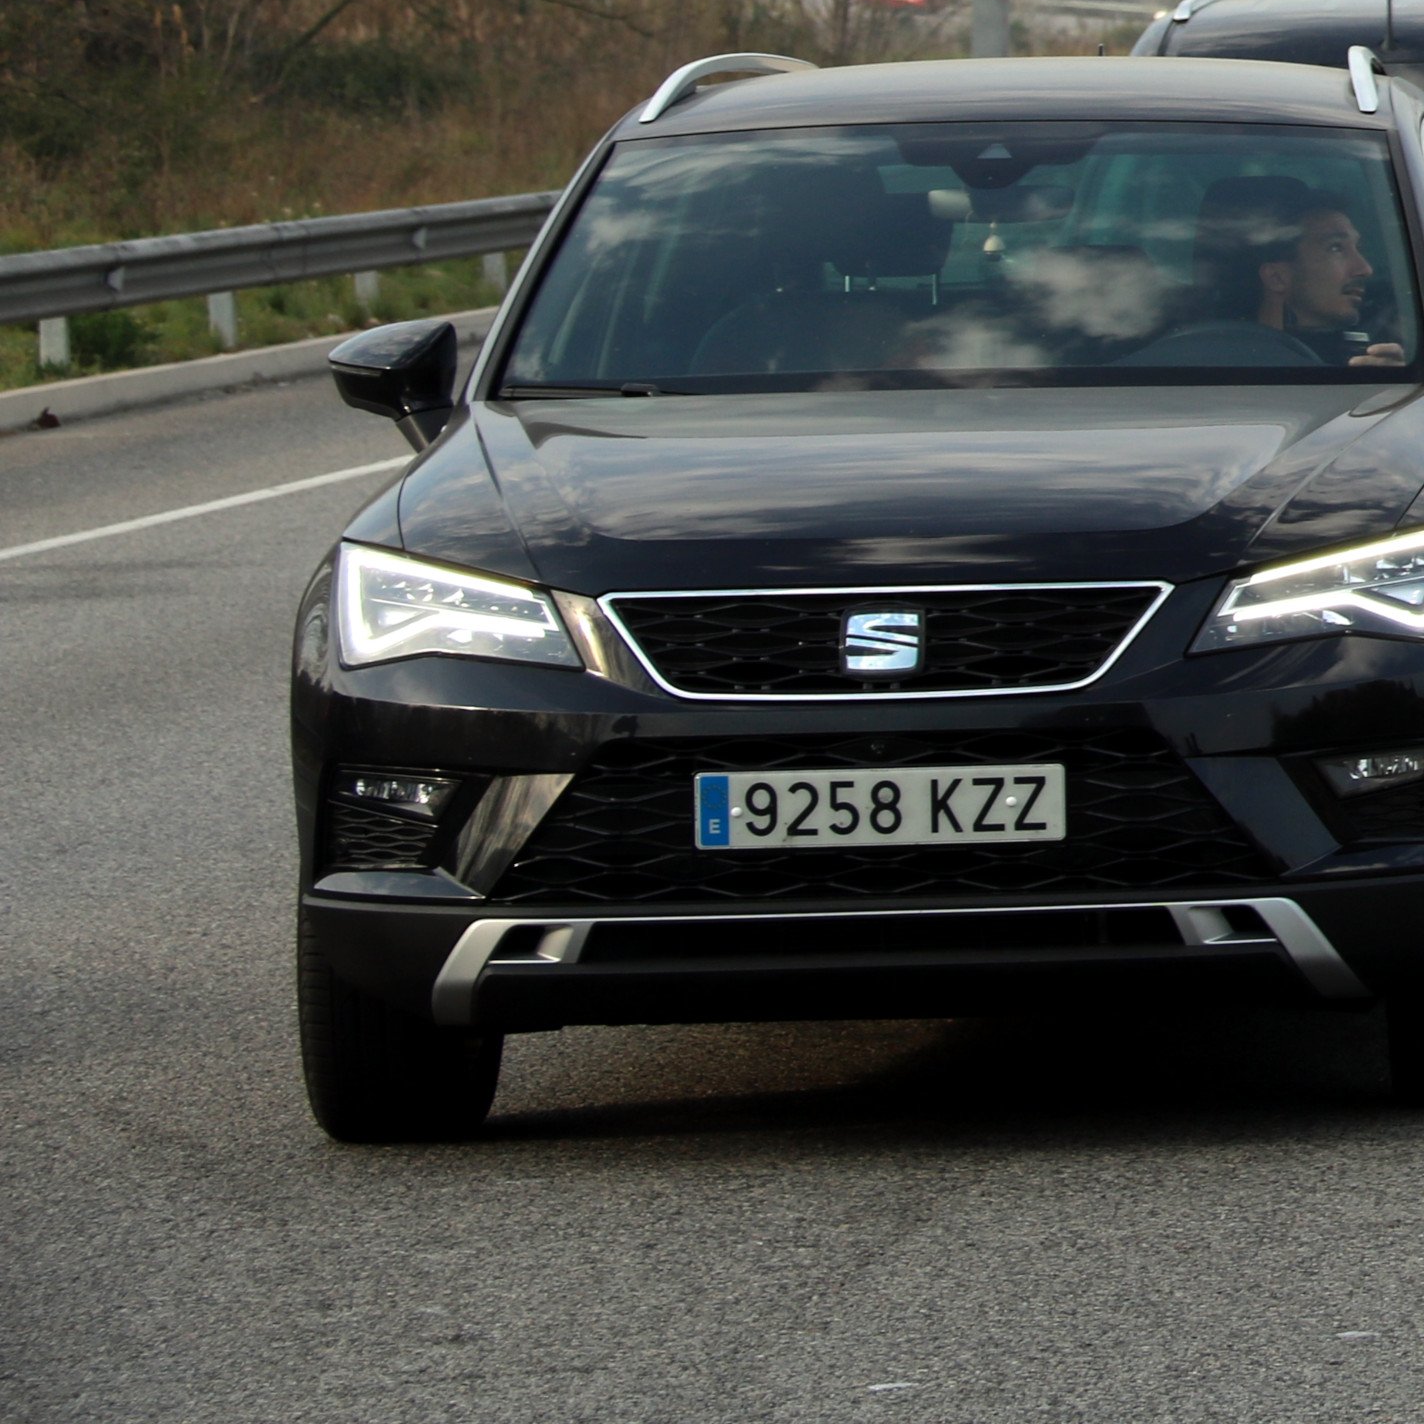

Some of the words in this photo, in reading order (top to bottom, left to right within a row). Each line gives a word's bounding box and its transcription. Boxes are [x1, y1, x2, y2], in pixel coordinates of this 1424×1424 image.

[708, 818, 721, 834] E
[744, 779, 903, 838] 9258
[929, 775, 1048, 834] KZZ
